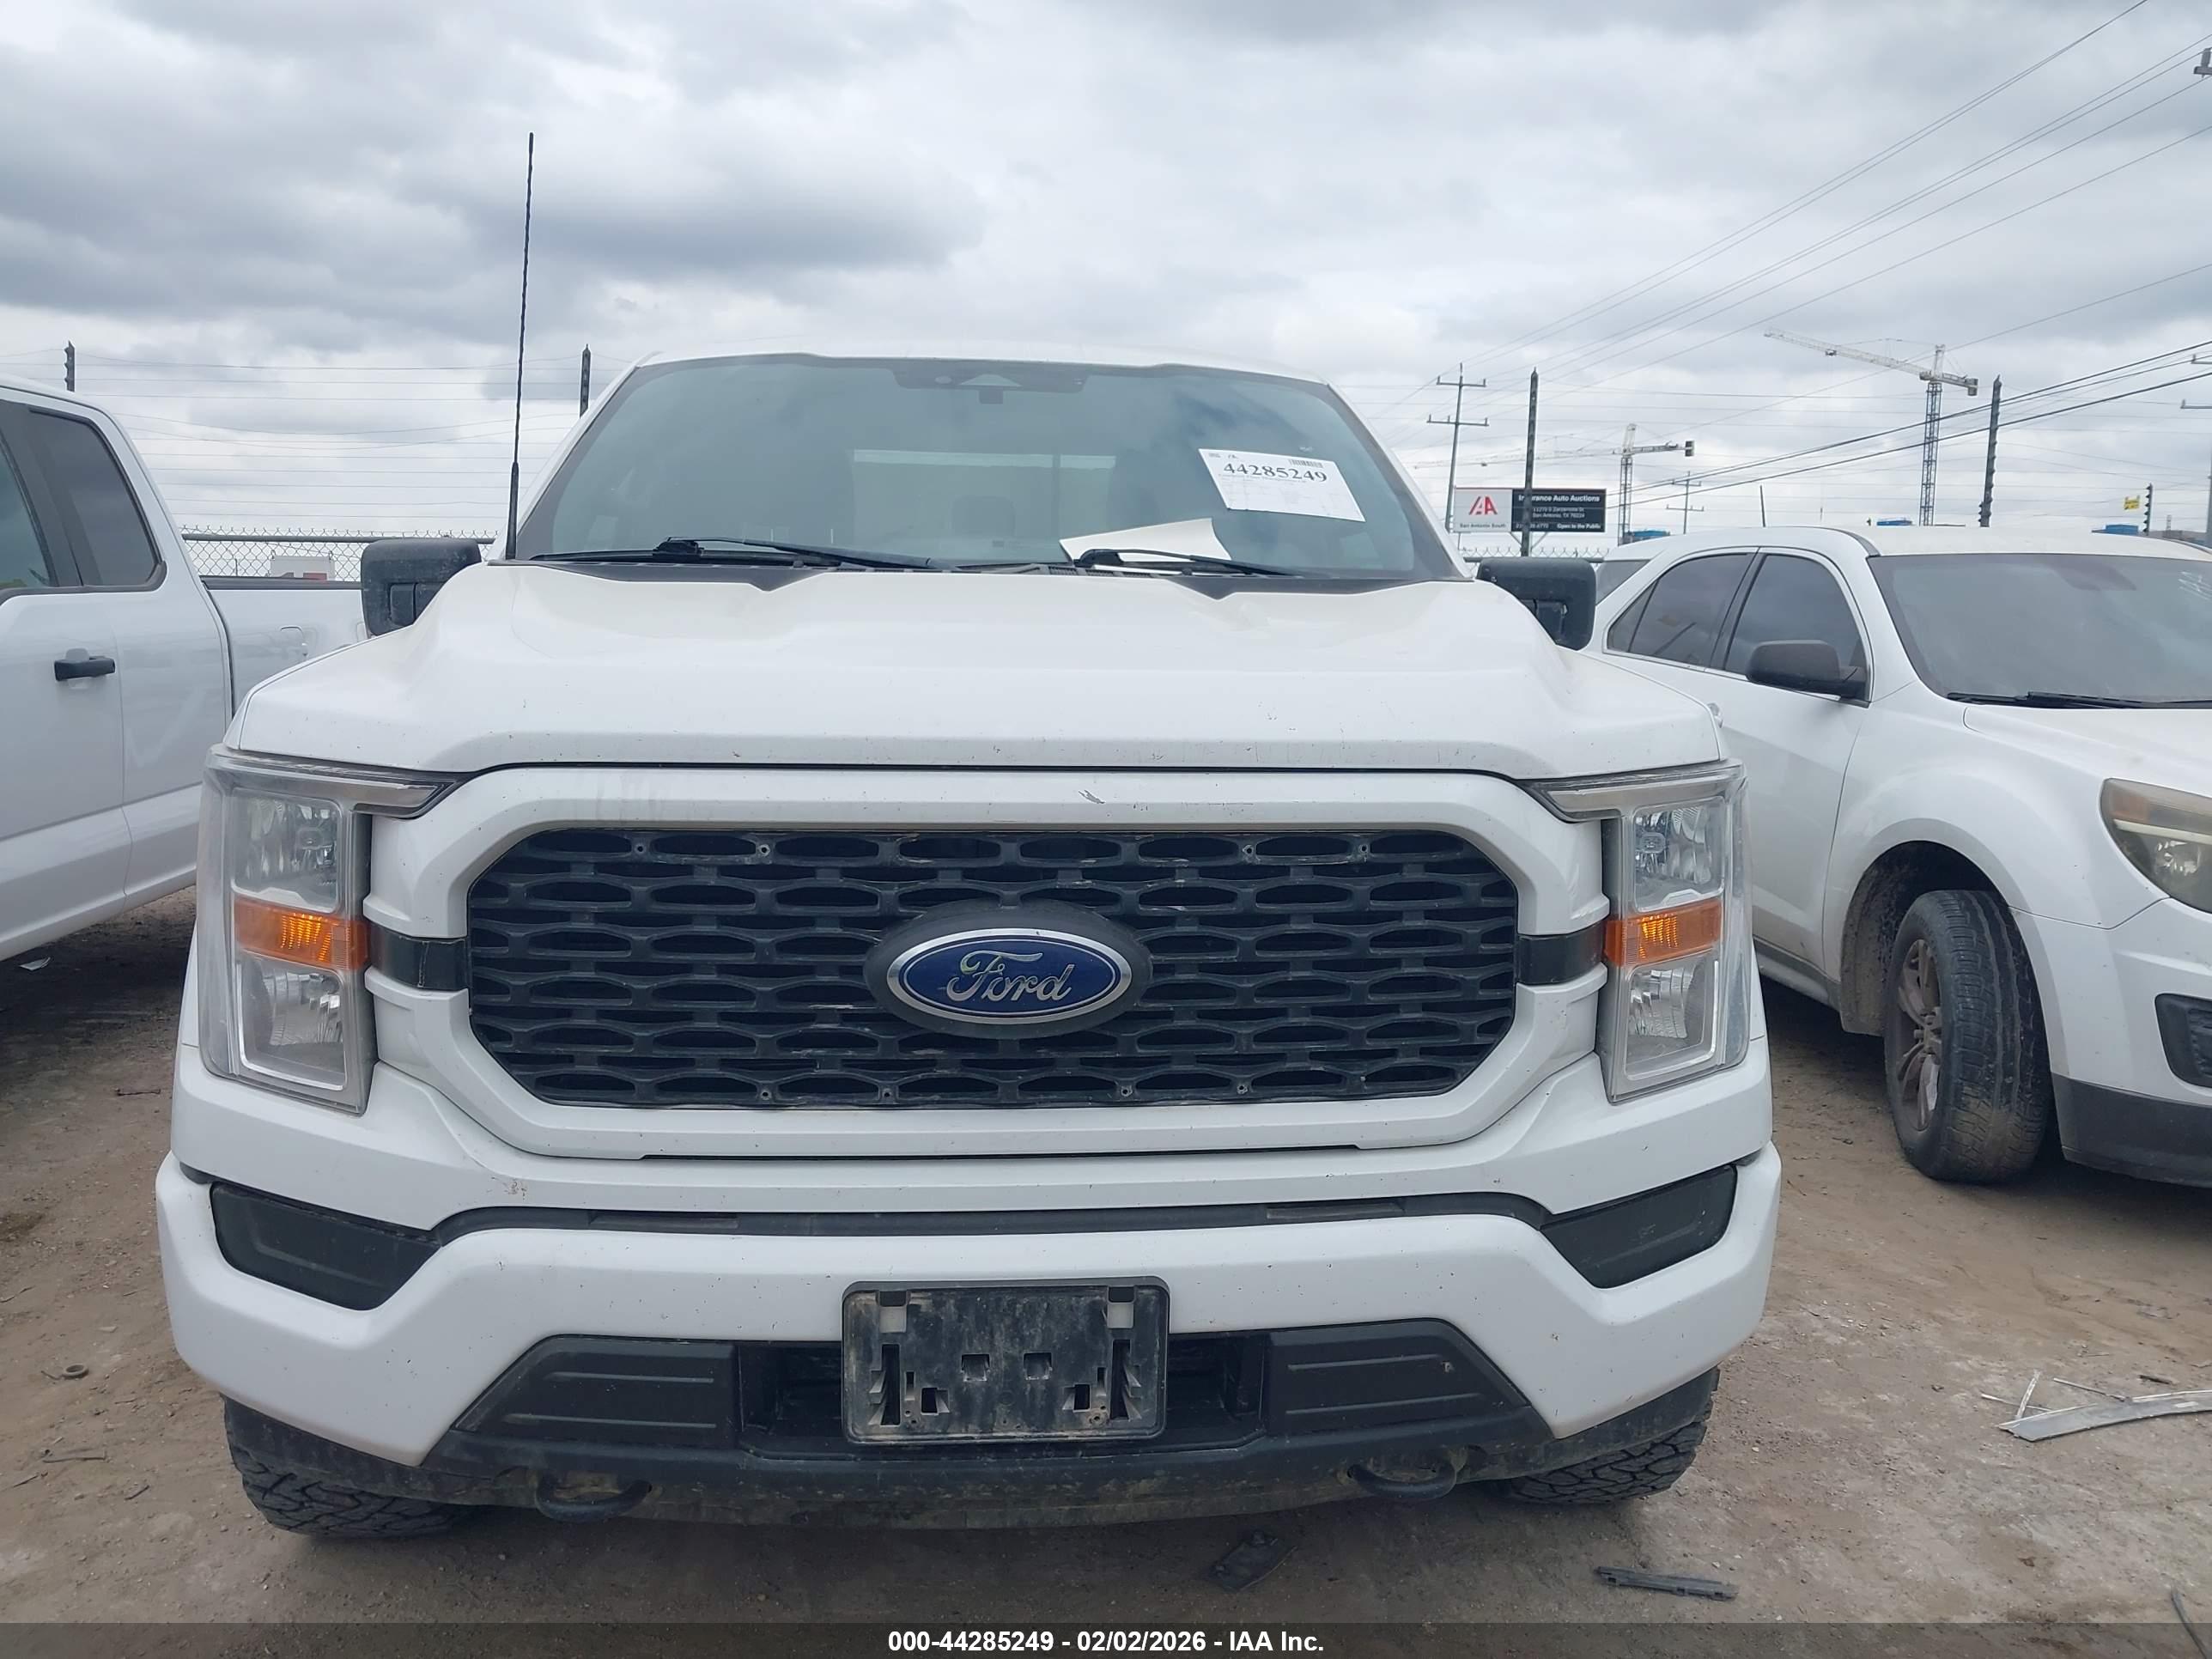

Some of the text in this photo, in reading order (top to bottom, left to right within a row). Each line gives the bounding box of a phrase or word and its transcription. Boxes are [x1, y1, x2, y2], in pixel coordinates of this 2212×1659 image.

[1224, 463, 1327, 482] 44285249
[1518, 494, 1601, 503] Inrance Auto Auctions
[946, 949, 1075, 1001] Ford
